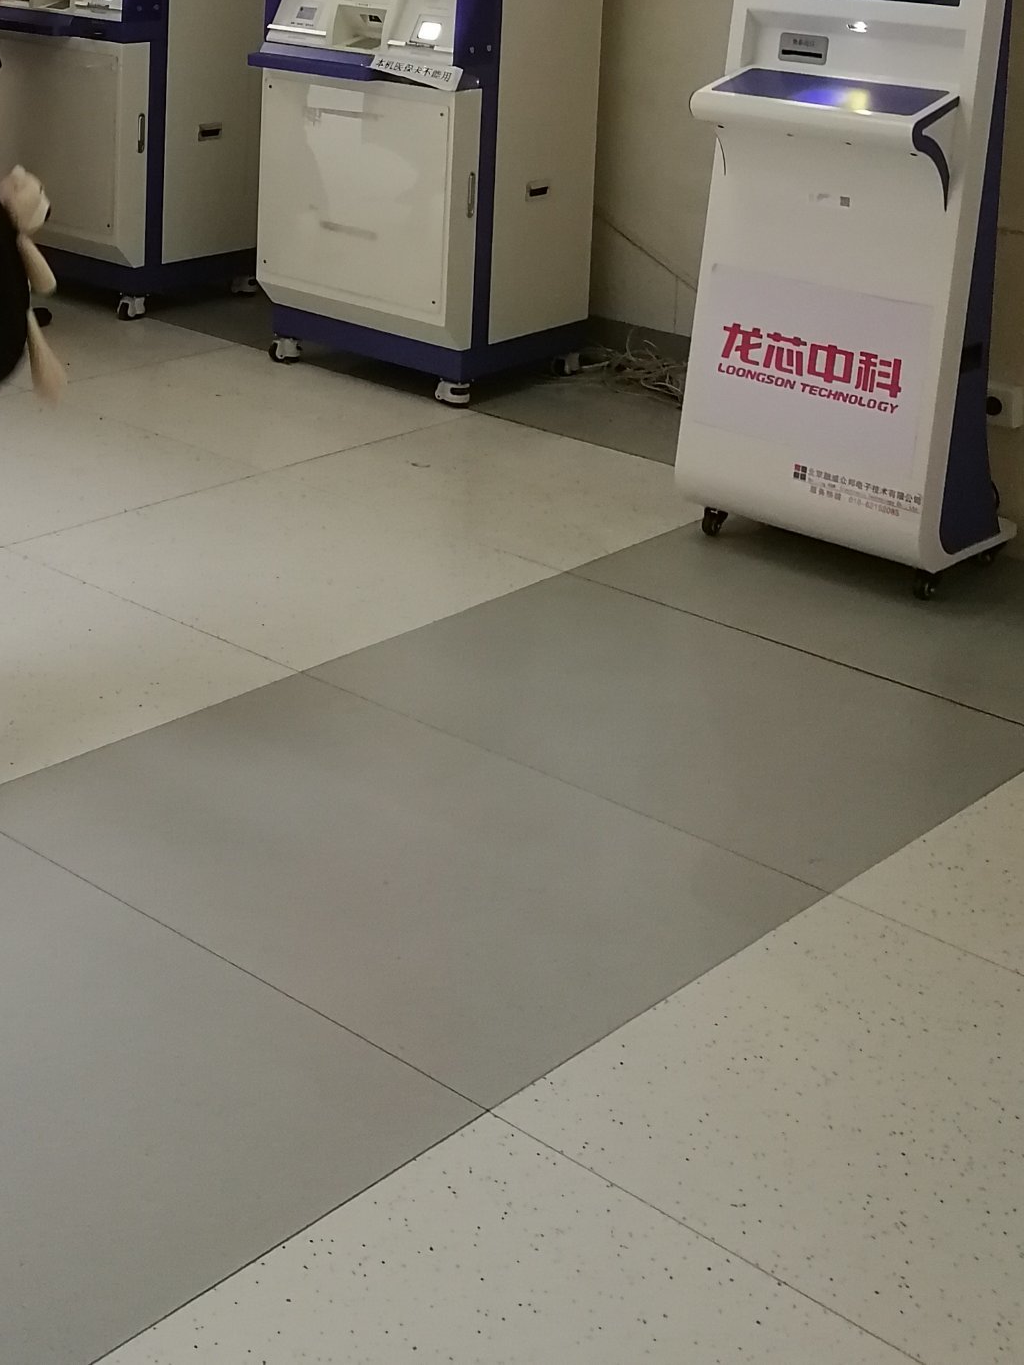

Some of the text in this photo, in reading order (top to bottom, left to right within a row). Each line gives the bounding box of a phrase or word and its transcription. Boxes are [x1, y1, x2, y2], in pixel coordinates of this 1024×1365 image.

[376, 58, 452, 83] 本机医保卡不能用
[721, 323, 902, 399] 龙芯中科
[717, 362, 899, 414] LOONGSON TECHNOLOGY
